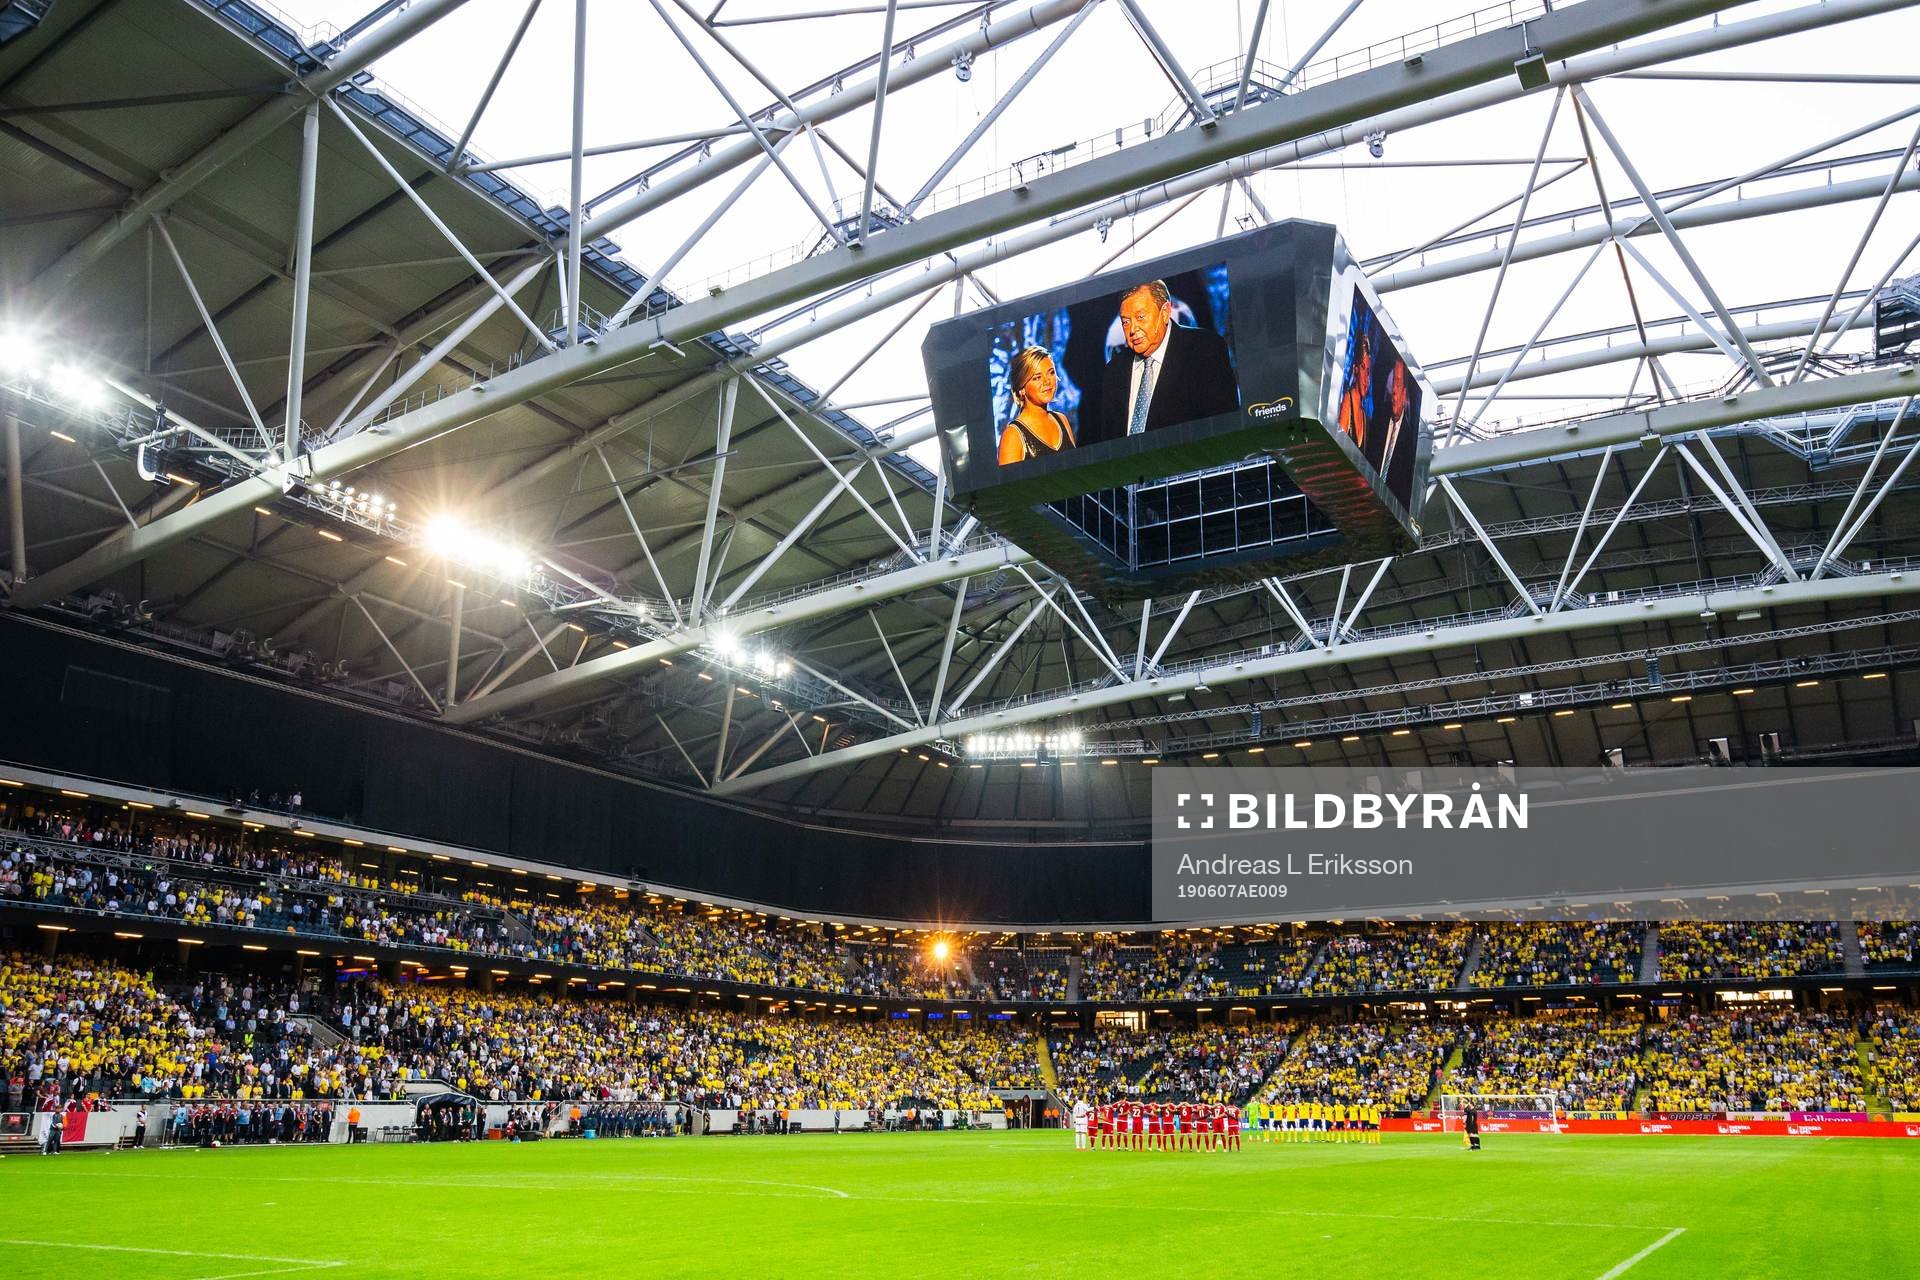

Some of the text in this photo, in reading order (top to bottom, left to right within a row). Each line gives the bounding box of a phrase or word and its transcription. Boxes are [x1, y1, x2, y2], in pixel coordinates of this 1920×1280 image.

[1254, 403, 1287, 417] friends
[1132, 1108, 1141, 1117] 22
[1182, 1108, 1187, 1116] 6
